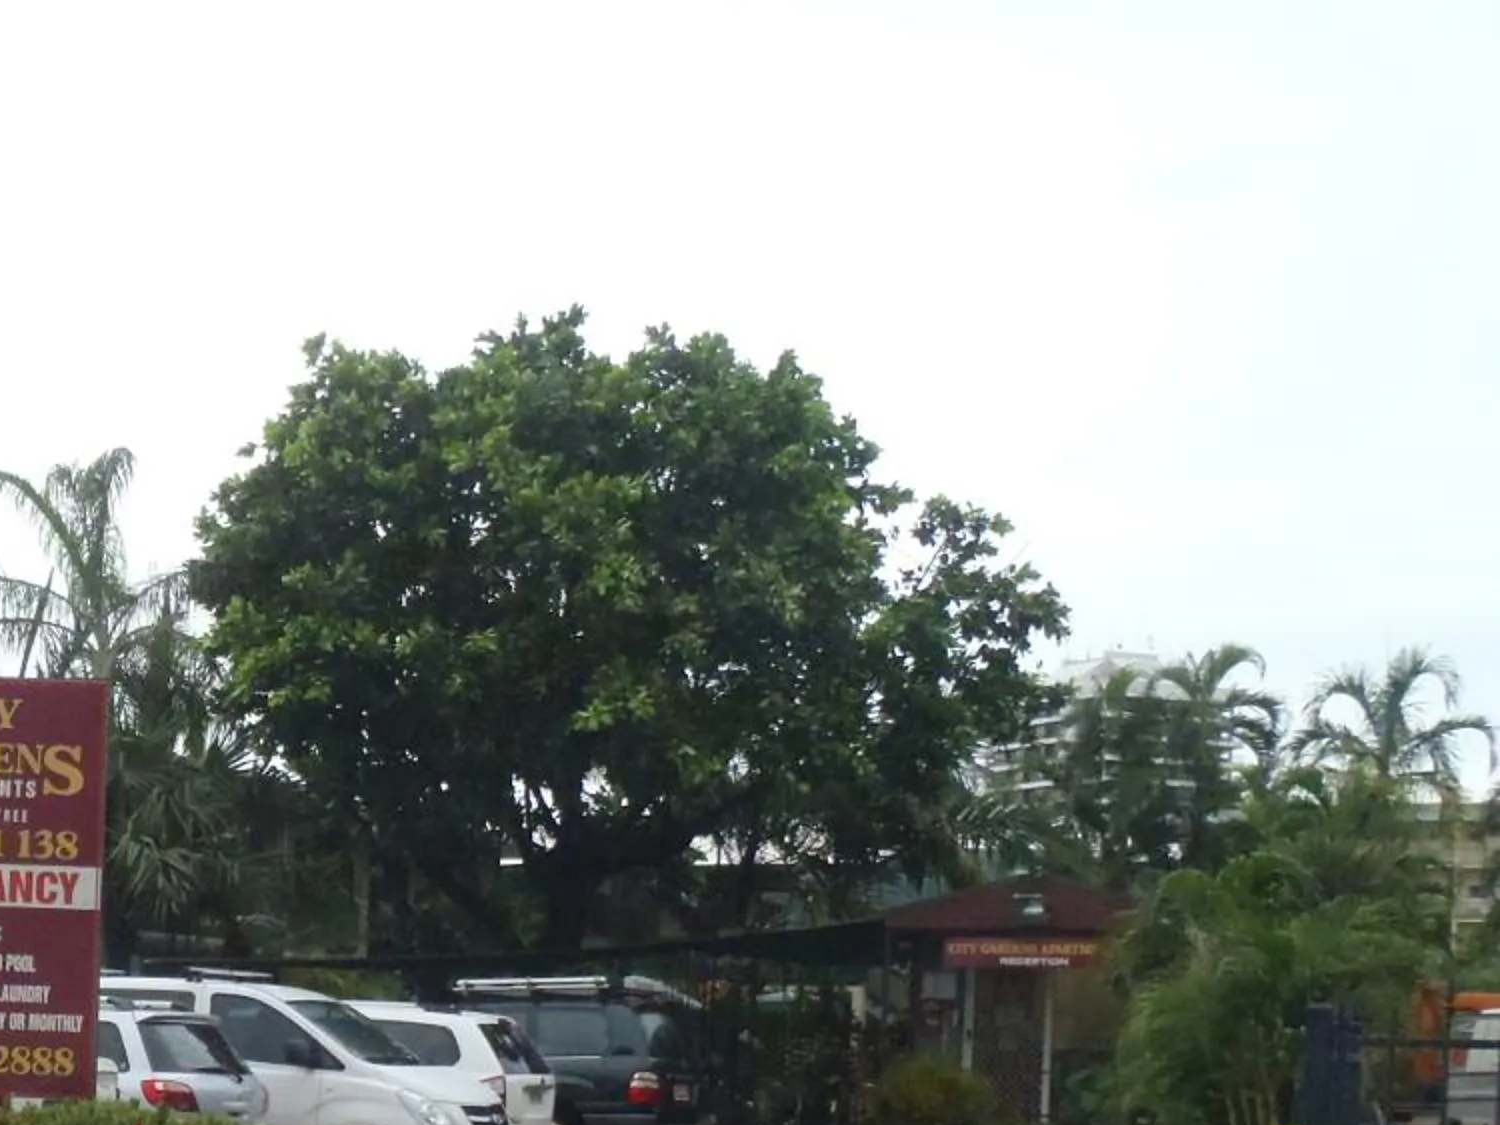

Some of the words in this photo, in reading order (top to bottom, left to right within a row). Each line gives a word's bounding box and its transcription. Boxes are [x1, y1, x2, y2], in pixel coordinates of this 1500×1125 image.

[16, 829, 78, 861] 138
[5, 954, 37, 973] POOL
[9, 1013, 25, 1031] OR
[28, 1013, 84, 1033] MONTHLY
